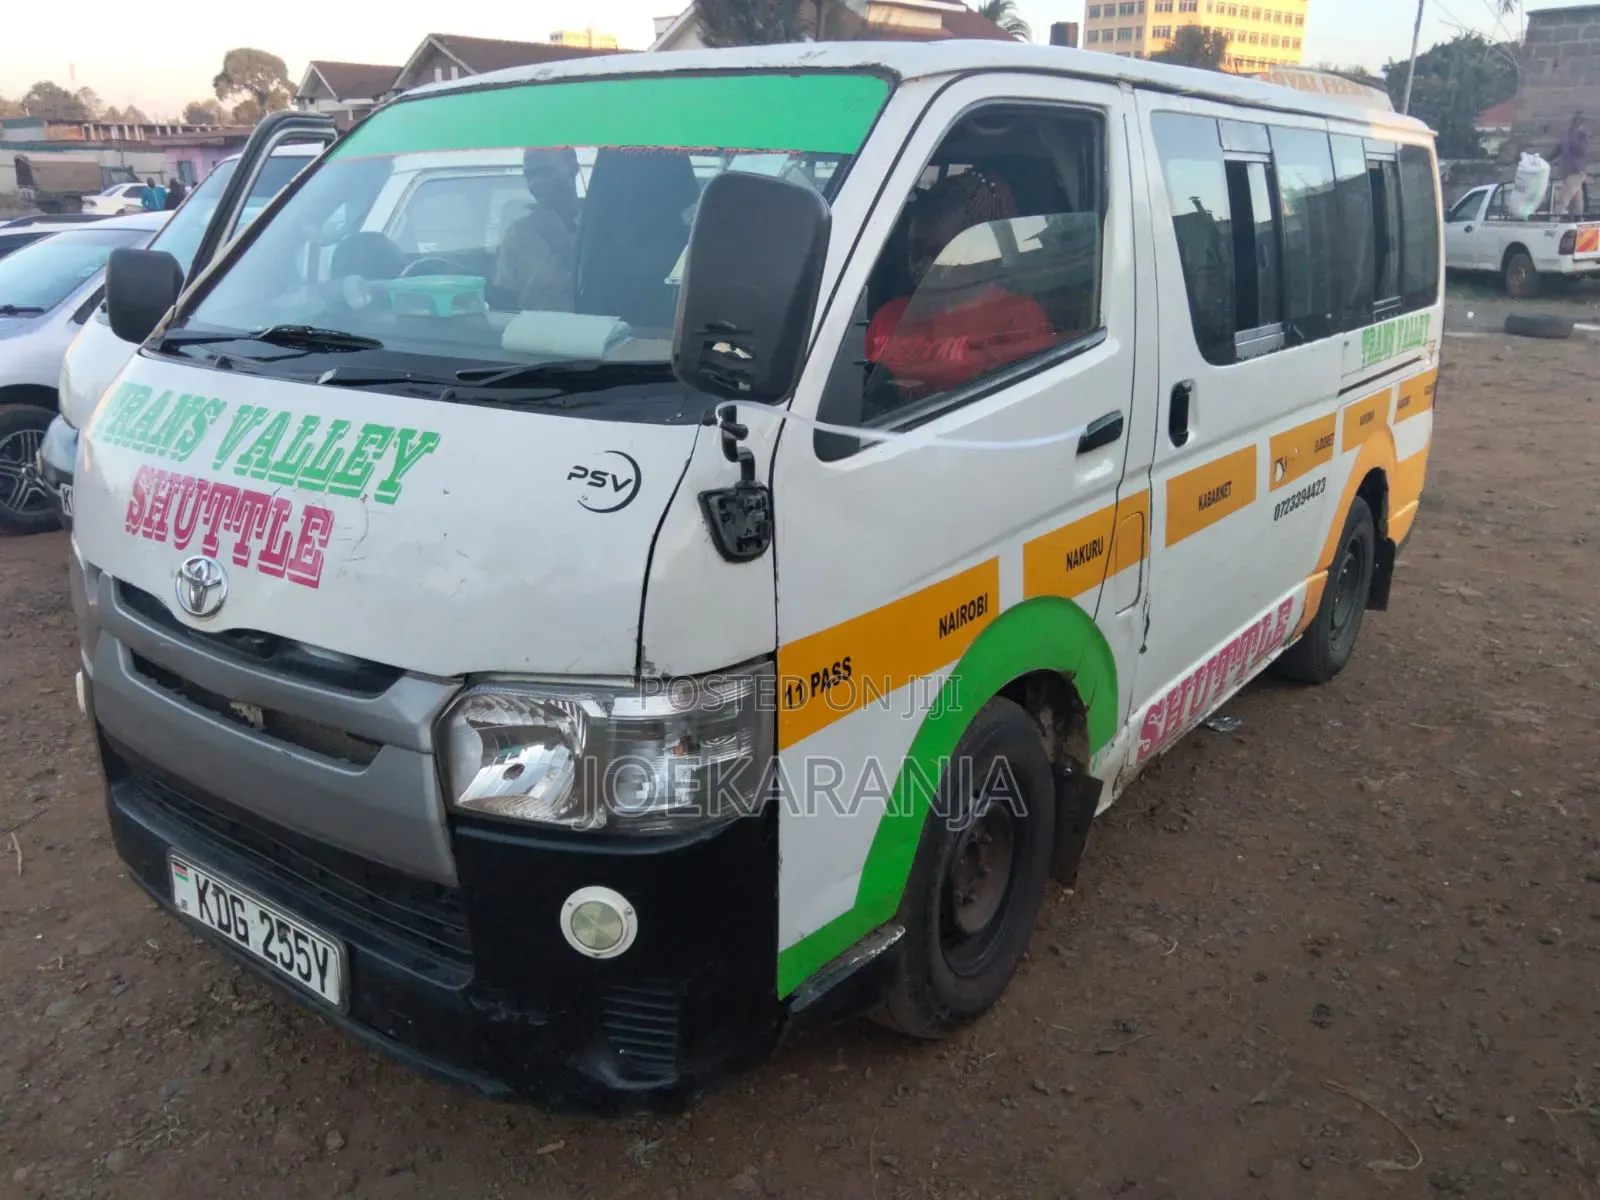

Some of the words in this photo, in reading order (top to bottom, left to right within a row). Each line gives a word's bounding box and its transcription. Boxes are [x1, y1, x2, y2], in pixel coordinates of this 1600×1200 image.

[100, 381, 228, 463] TRANS
[212, 403, 440, 506] VALLEY
[566, 464, 633, 493] PSV
[125, 464, 335, 589] SHUTTLE
[1065, 536, 1104, 572] NAKURU
[938, 592, 990, 640] NAIROBI
[784, 682, 807, 711] 11
[811, 656, 852, 695] PASS
[1136, 595, 1294, 764] SHUTTLE
[195, 872, 251, 948] KDG
[259, 910, 329, 994] 255Y
